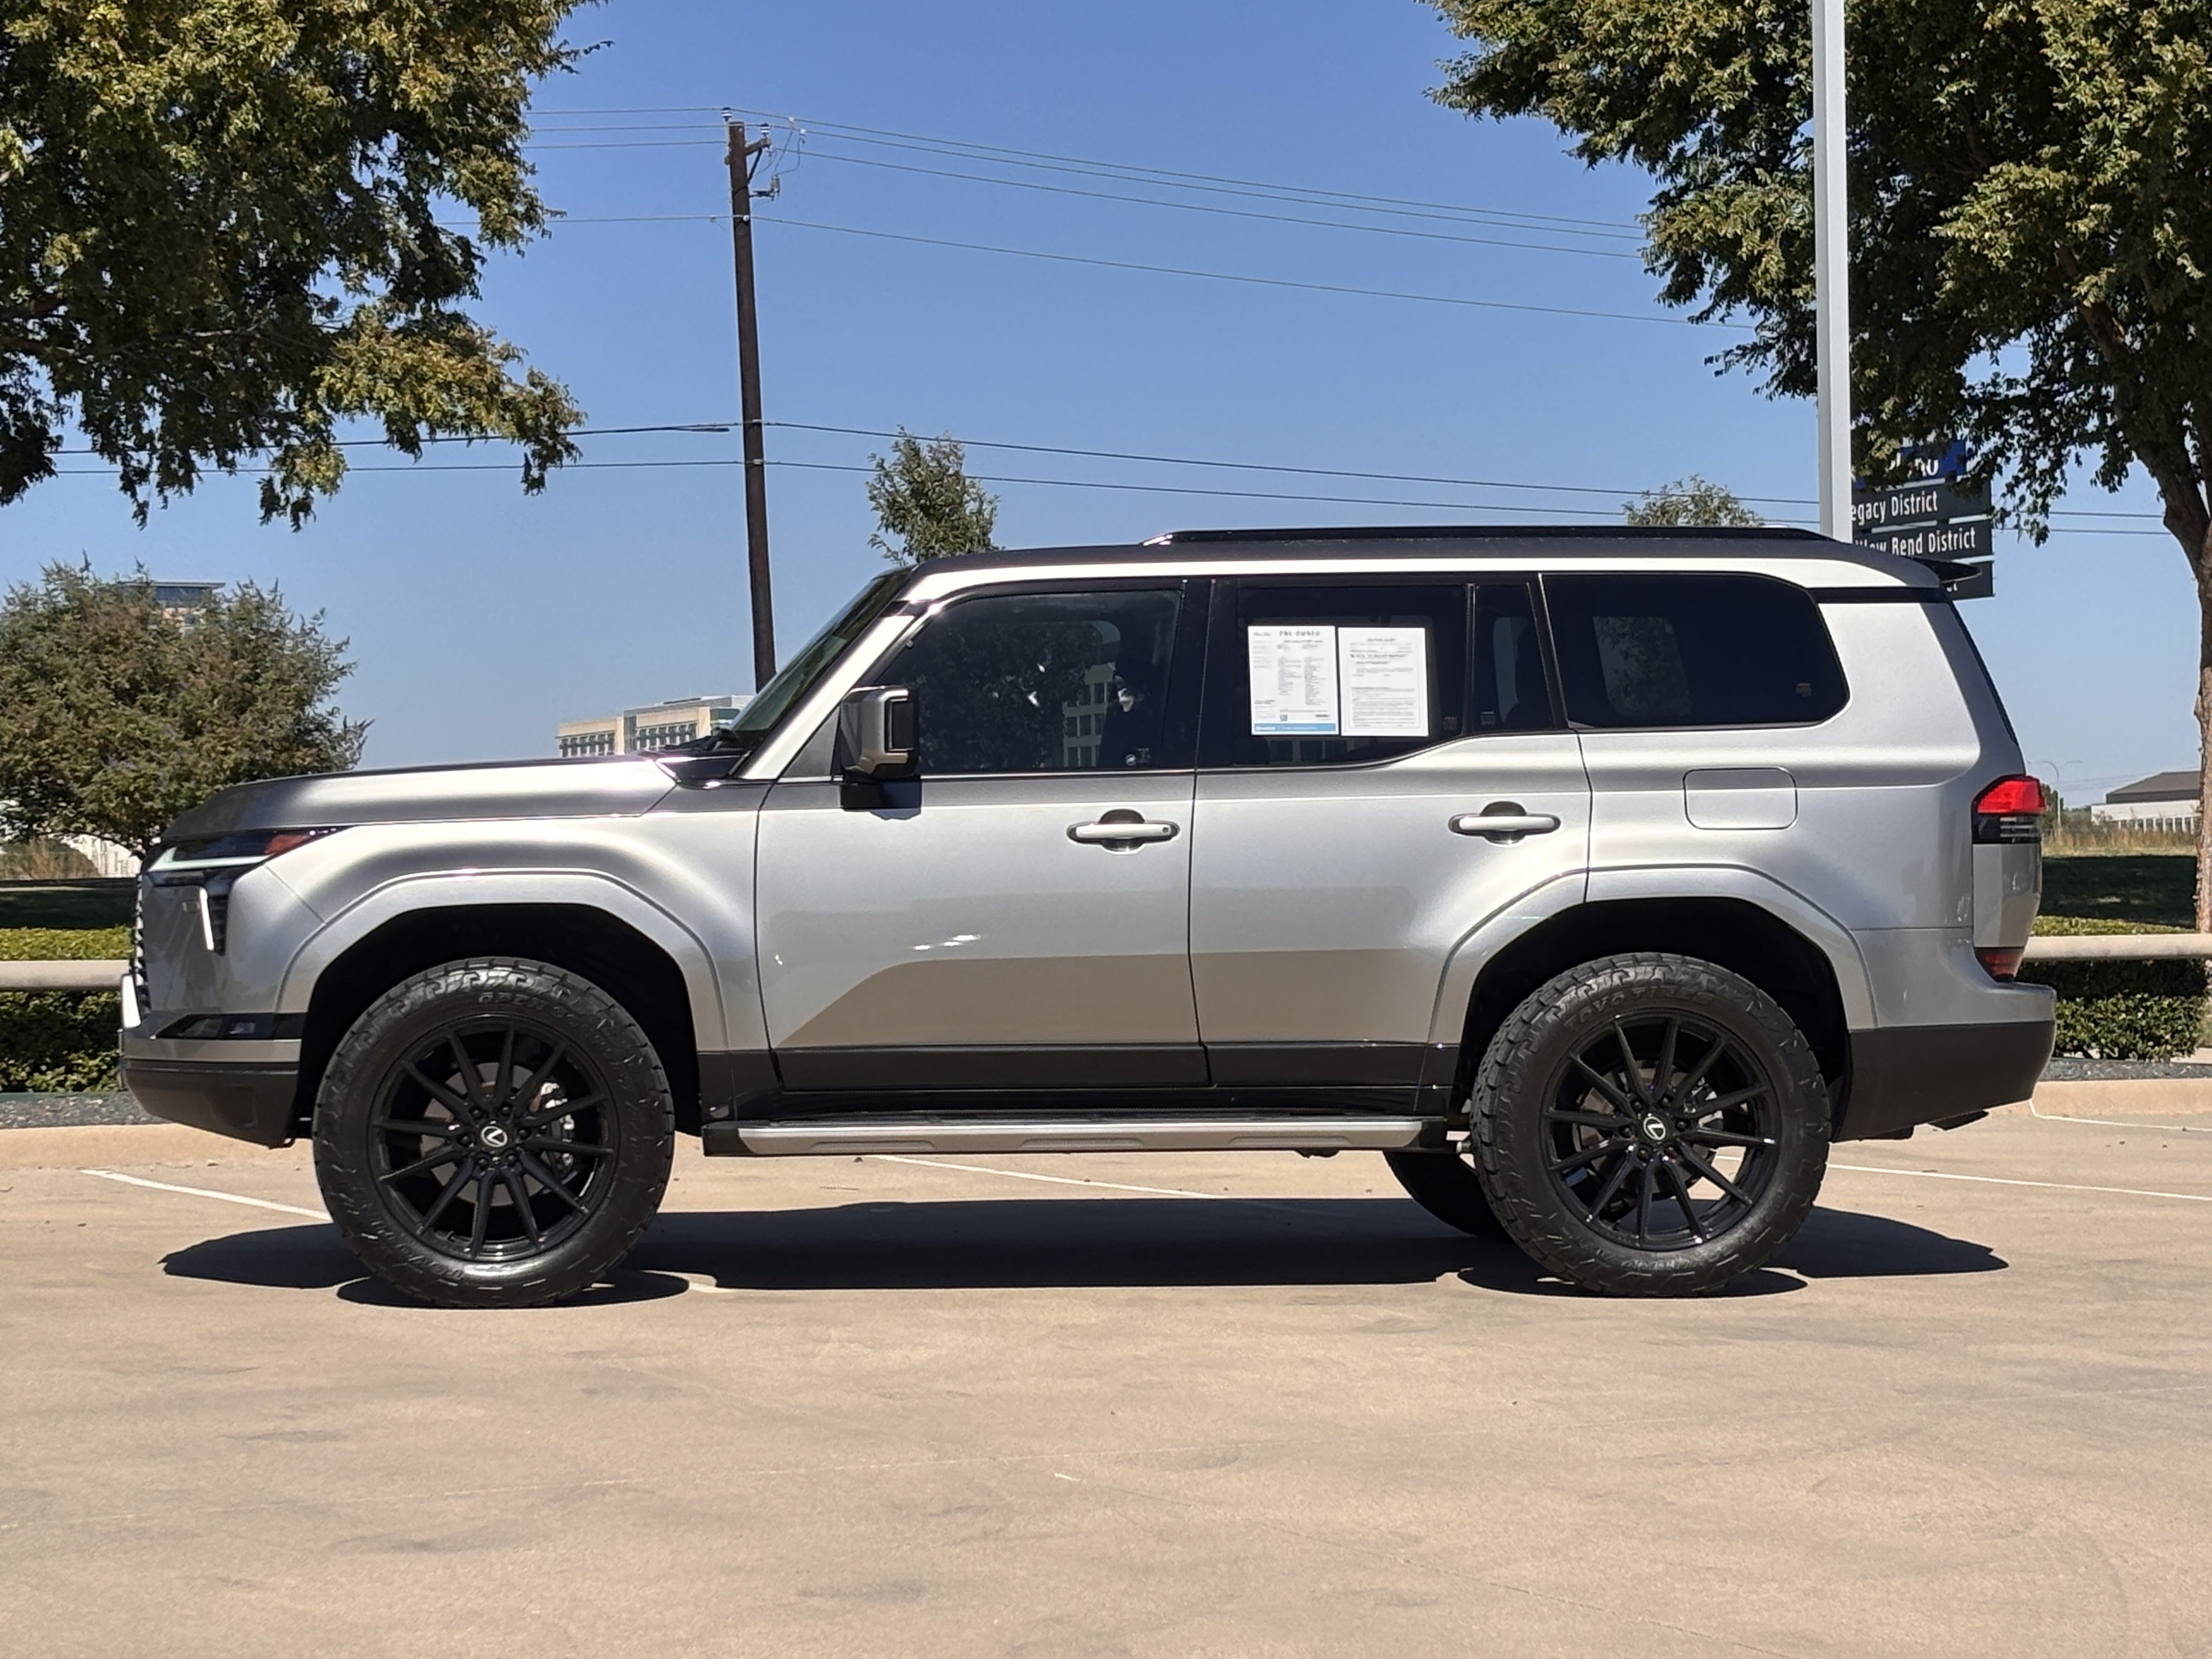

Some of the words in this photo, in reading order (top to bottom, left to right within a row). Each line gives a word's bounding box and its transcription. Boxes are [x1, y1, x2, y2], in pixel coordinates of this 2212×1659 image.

[1852, 501, 1886, 526] egacy
[1892, 490, 1938, 516] District
[1928, 527, 1975, 553] District
